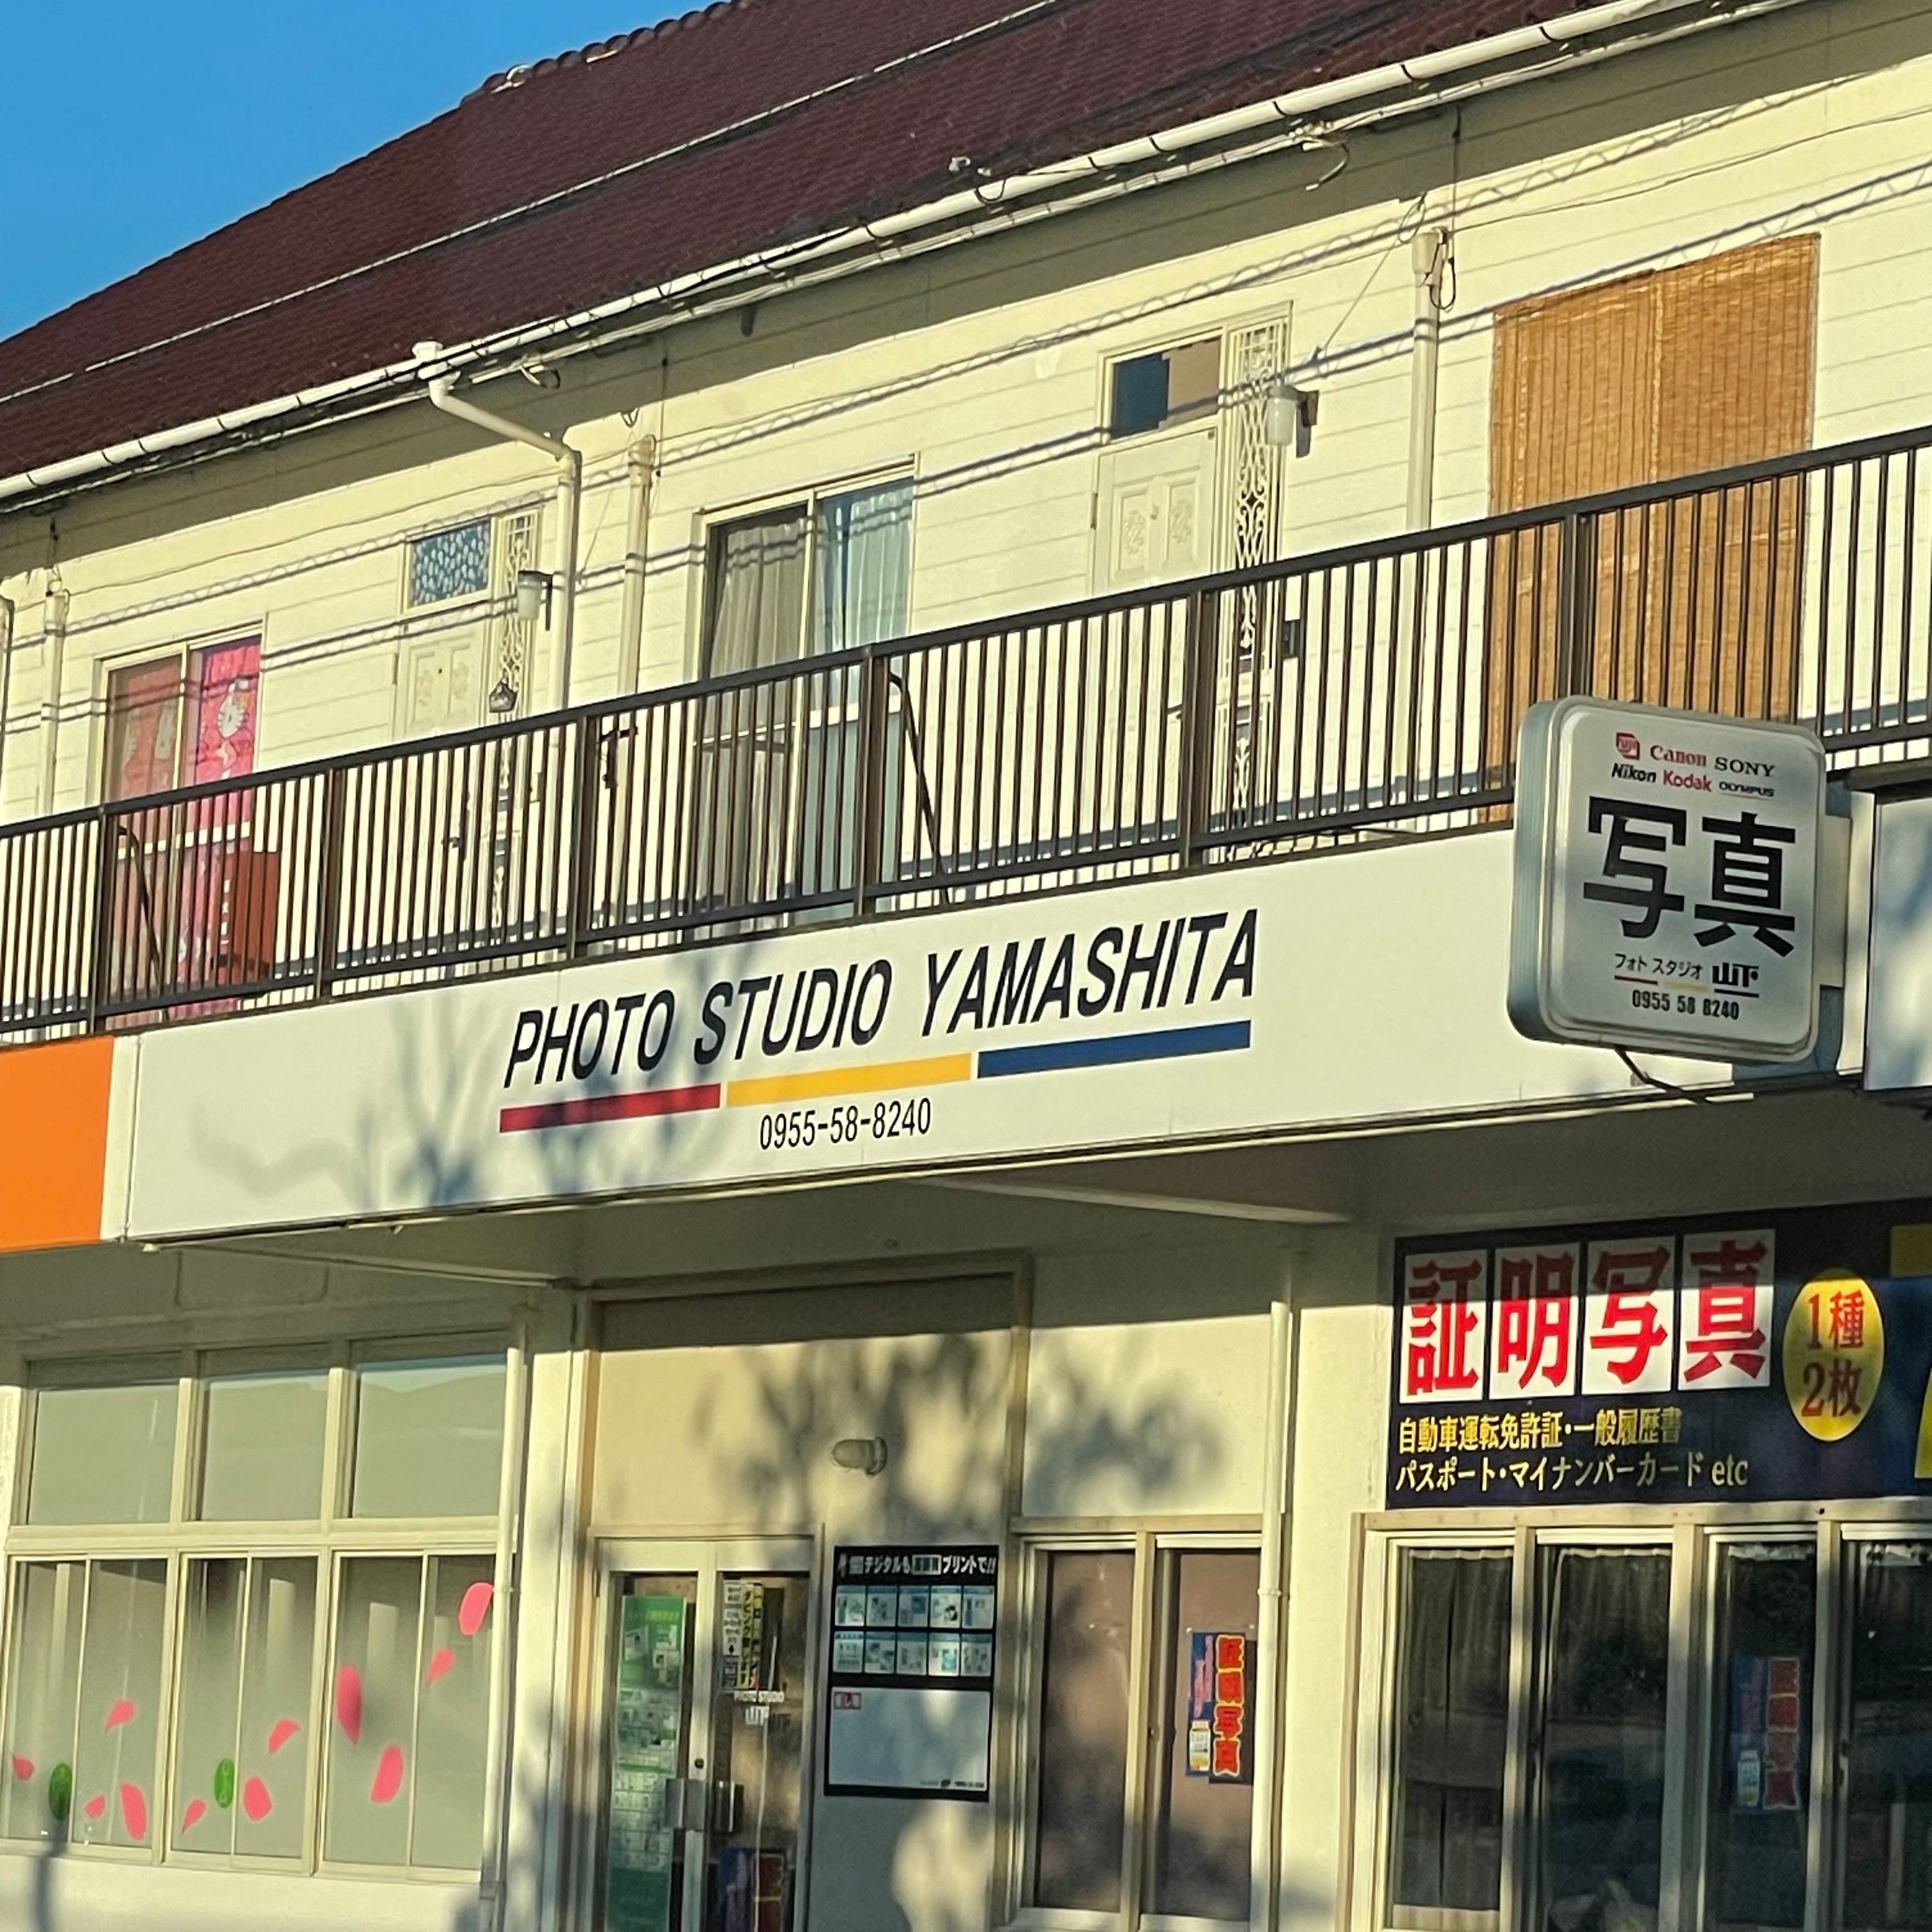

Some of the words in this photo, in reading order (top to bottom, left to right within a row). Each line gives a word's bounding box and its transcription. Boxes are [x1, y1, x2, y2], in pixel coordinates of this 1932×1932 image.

[1612, 763, 1657, 783] Nikon
[1662, 770, 1712, 792] Kodak
[1650, 745, 1706, 767] Canon
[1715, 757, 1775, 778] SONY
[1584, 796, 1796, 958] 写真
[504, 989, 675, 1089] PHOTO
[694, 958, 893, 1066] STUDIO
[922, 908, 1259, 1036] YAMASHITA
[1712, 962, 1759, 987] 山下
[1632, 990, 1670, 1011] 0955
[1677, 995, 1696, 1014] 58
[1703, 998, 1740, 1020] 8240
[760, 1098, 932, 1150] 0955-58-8240
[1407, 1240, 1768, 1395] 証明写真
[1809, 1289, 1864, 1350] 1種
[1801, 1358, 1863, 1417] 2枚
[1395, 1452, 1705, 1492] パスポート・マイナンバーカード
[1712, 1455, 1749, 1487] etc
